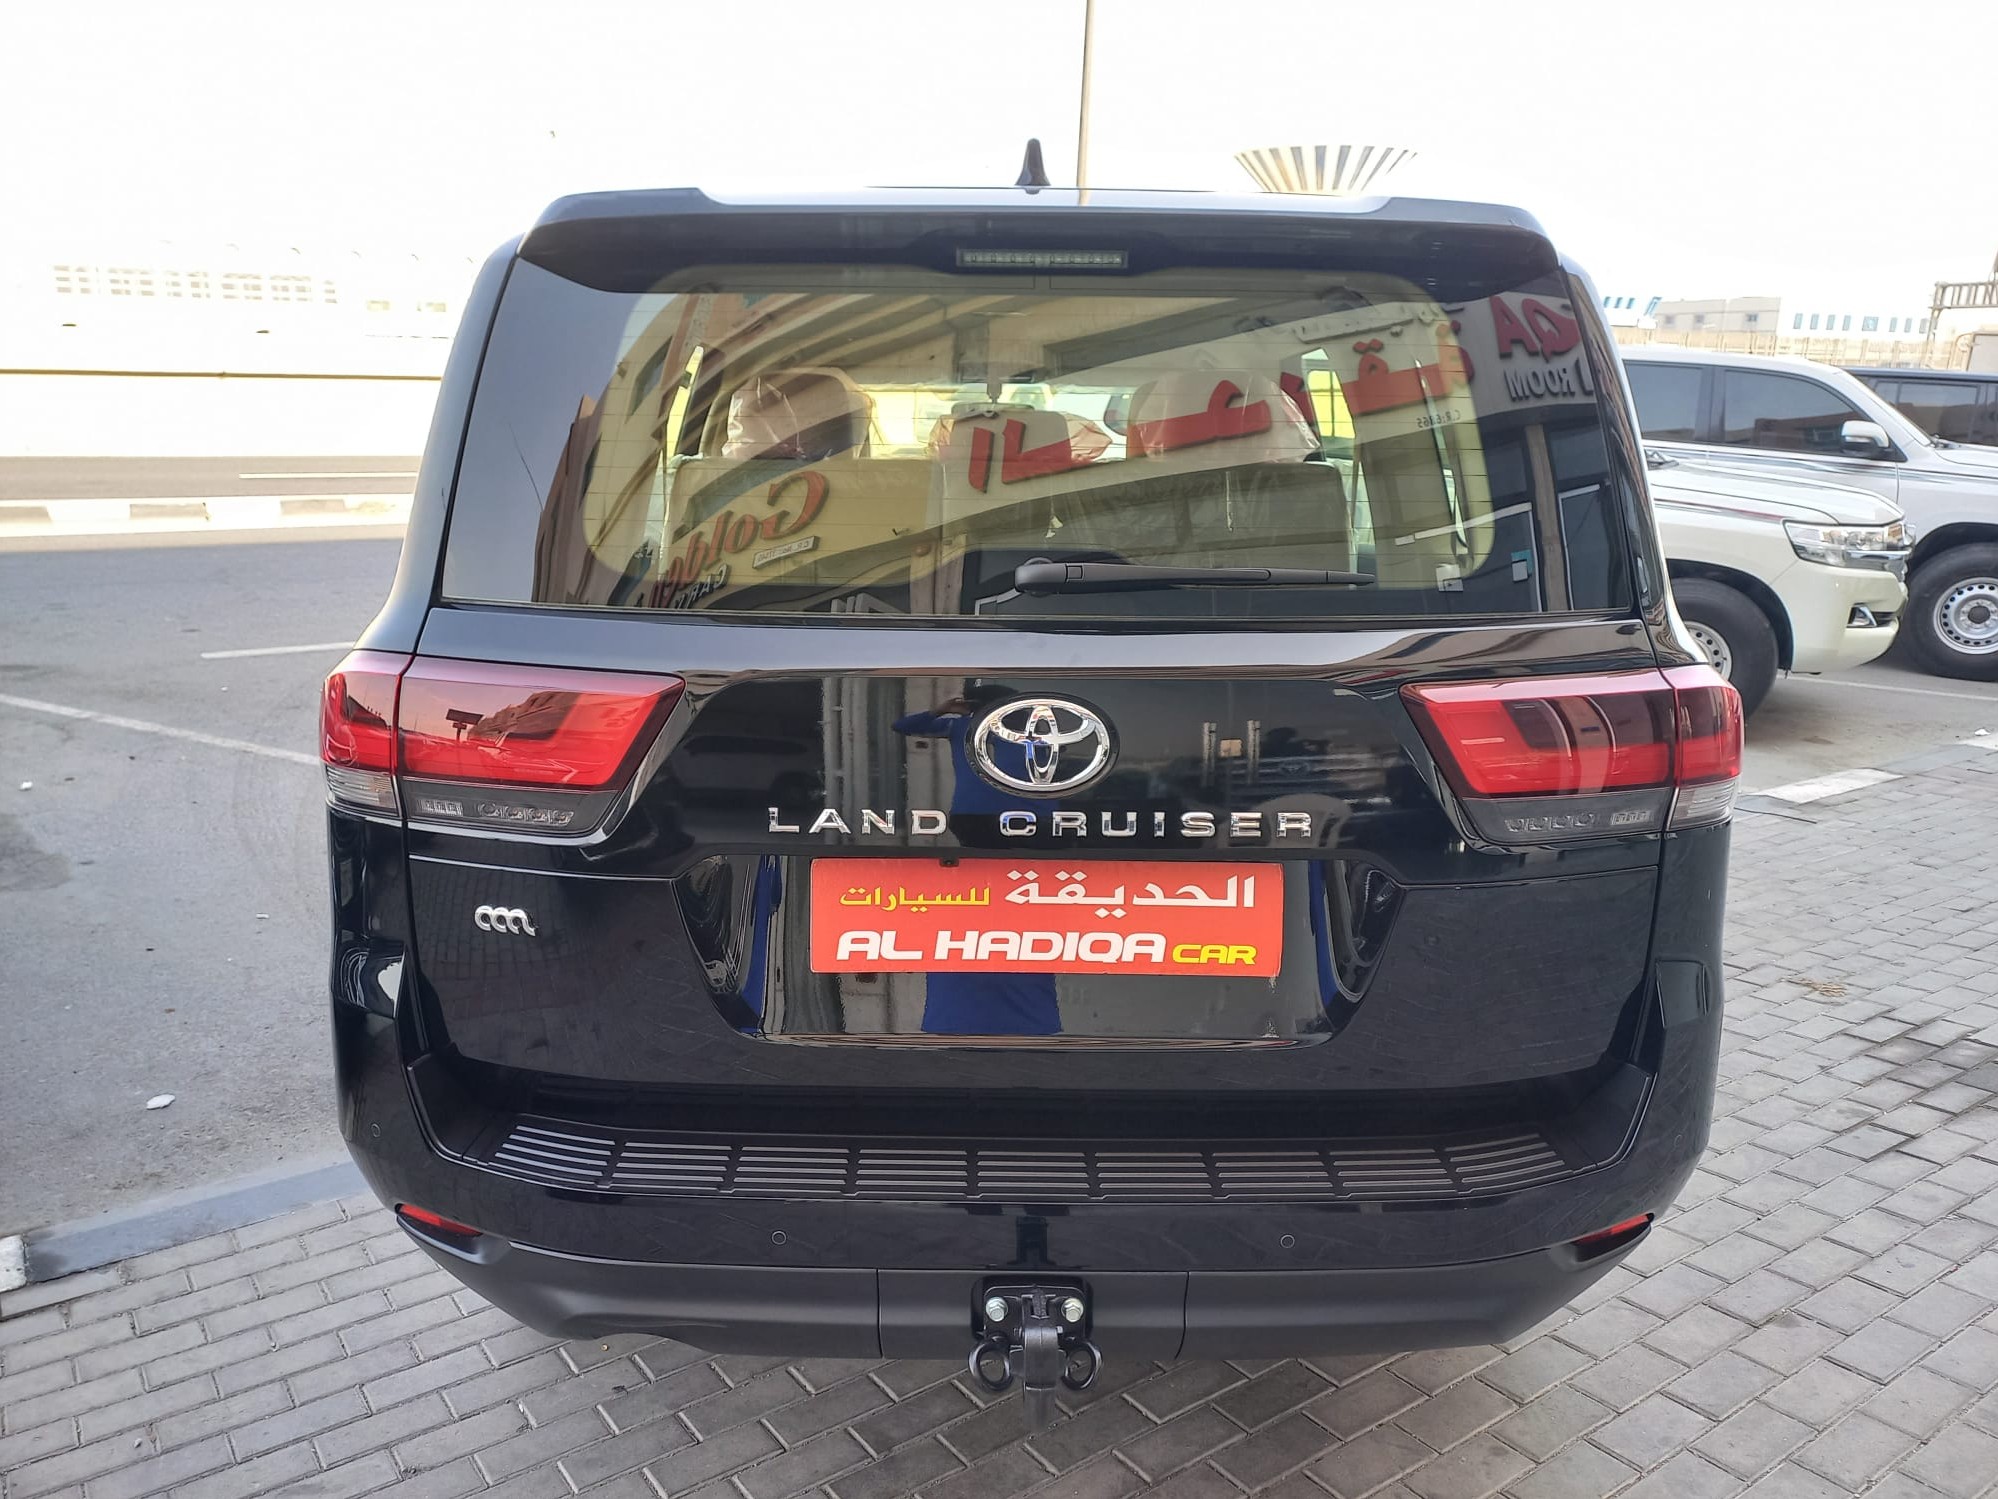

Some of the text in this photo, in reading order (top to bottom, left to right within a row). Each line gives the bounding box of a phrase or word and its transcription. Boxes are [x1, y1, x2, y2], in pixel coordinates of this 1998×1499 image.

[769, 806, 1313, 840] LAND CRUISER
[840, 870, 1255, 919] الحديقة للسيارات
[836, 931, 1257, 967] AL HADIQA CAR
